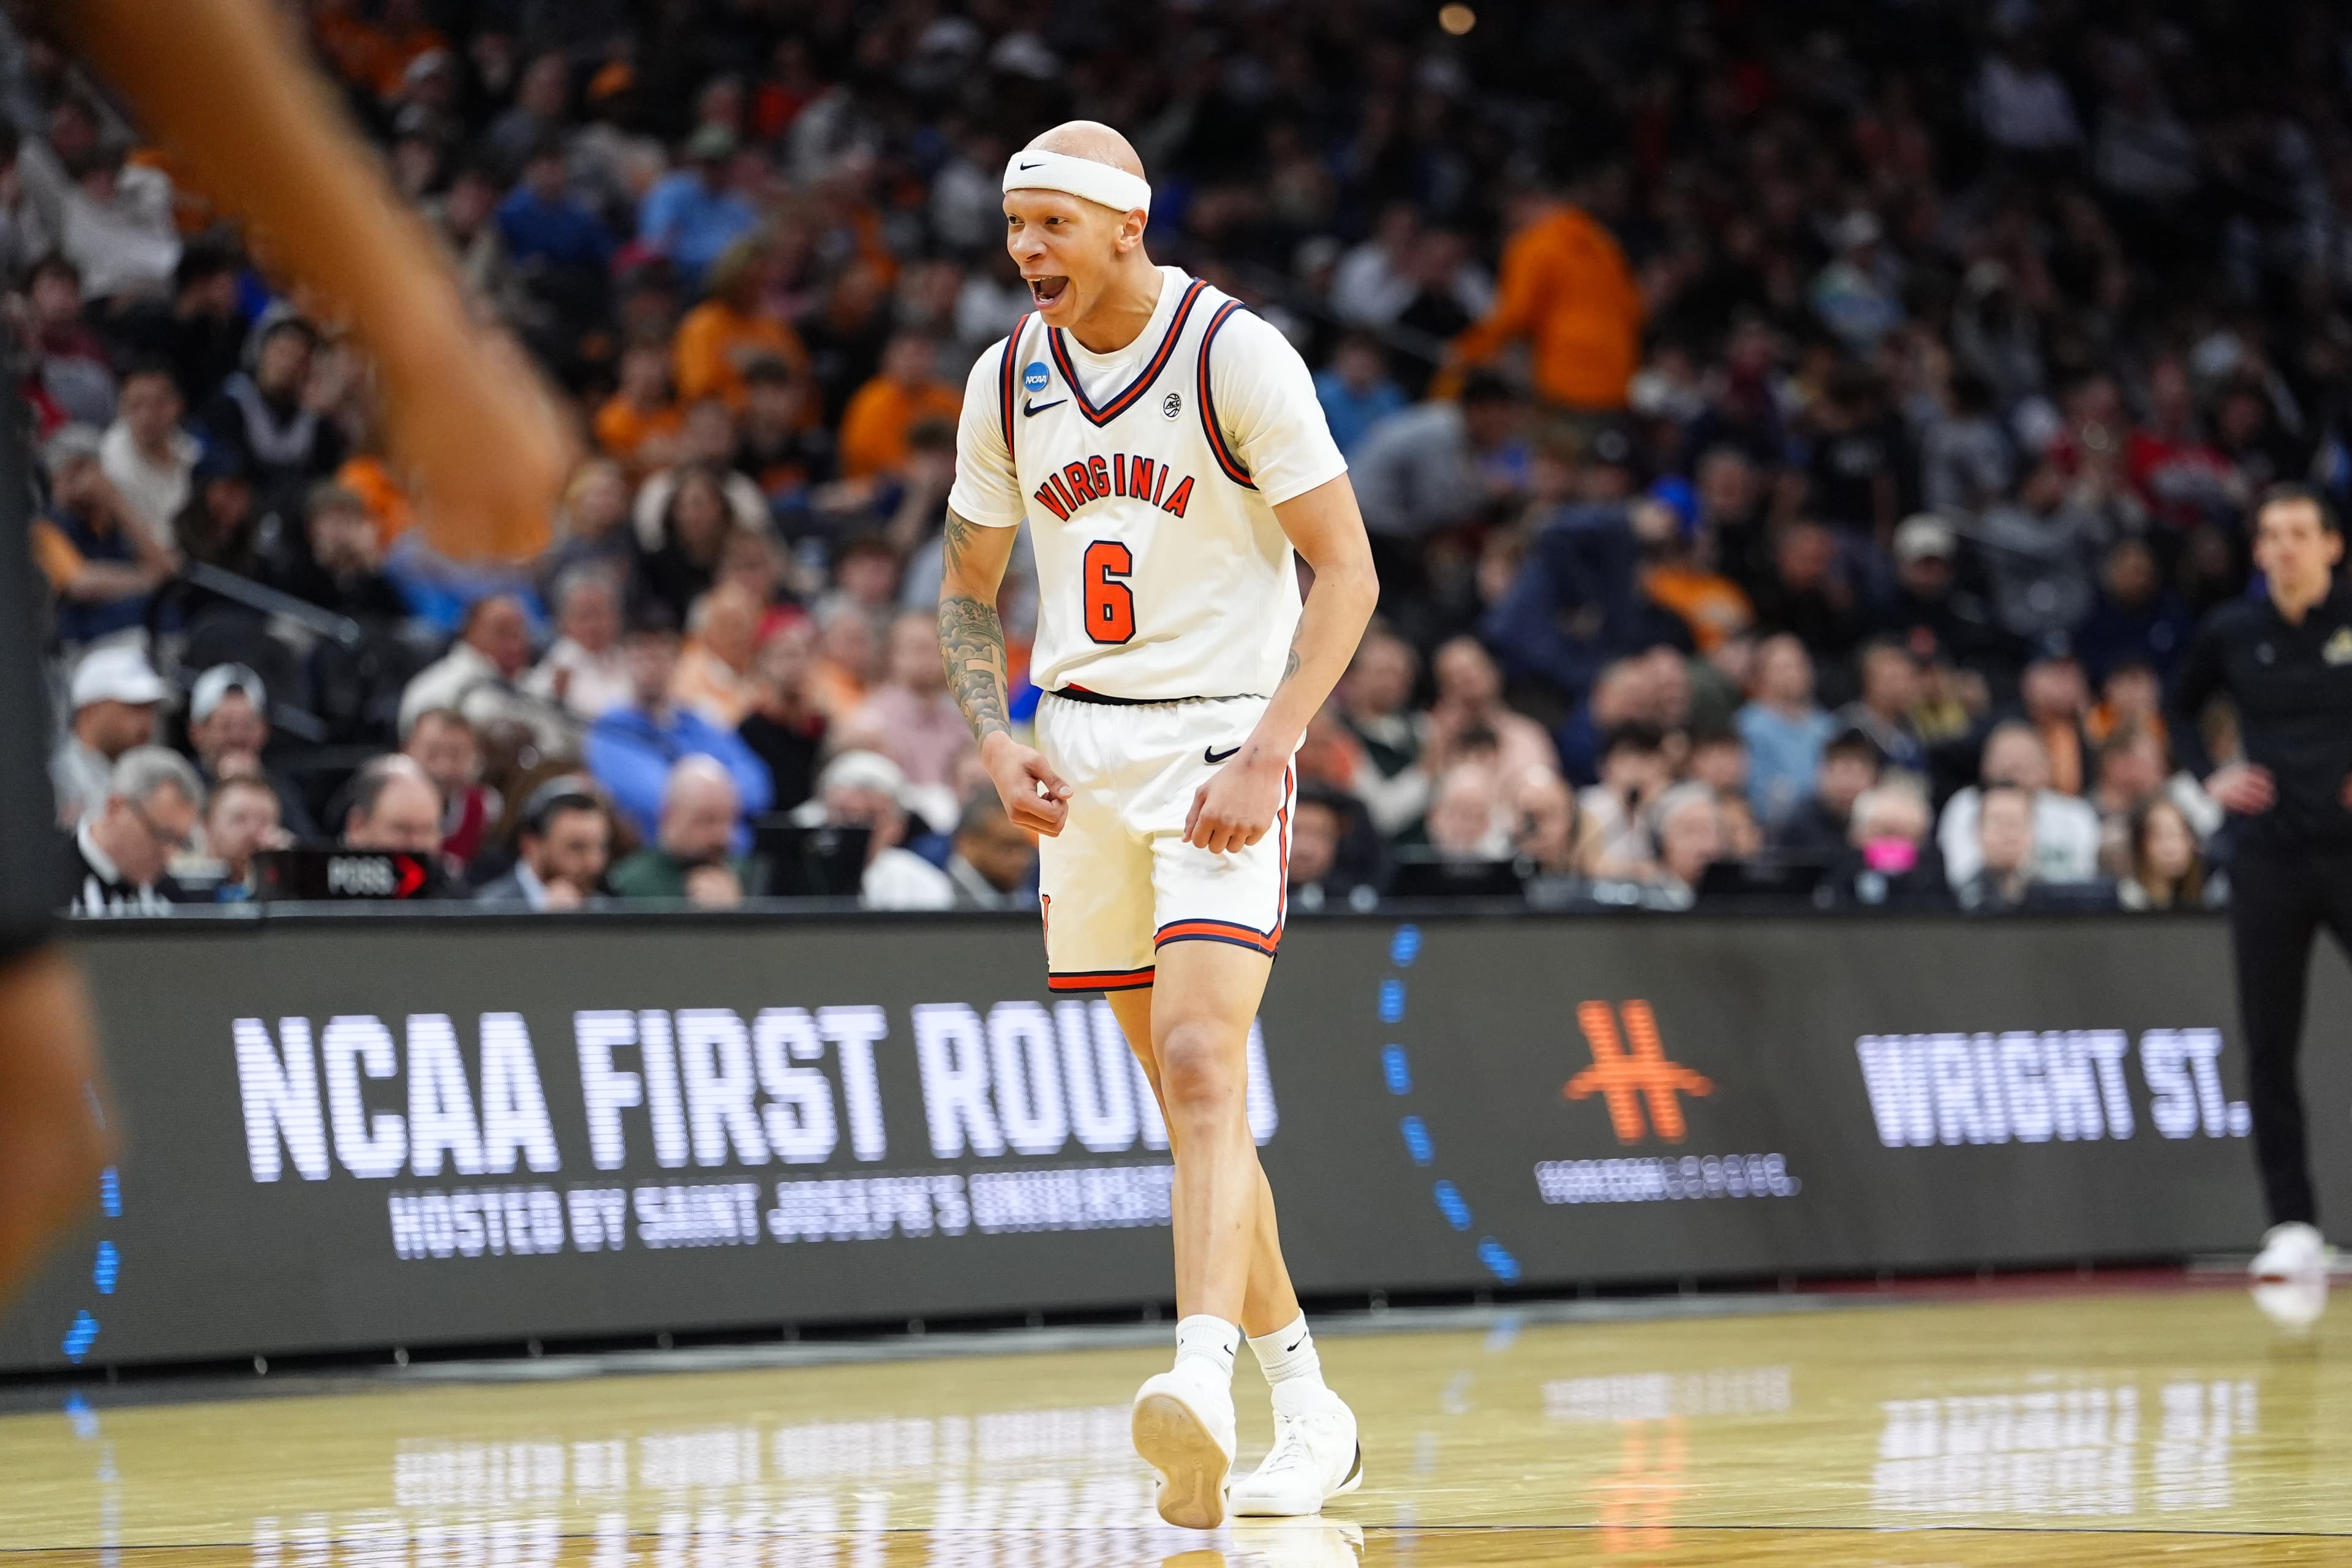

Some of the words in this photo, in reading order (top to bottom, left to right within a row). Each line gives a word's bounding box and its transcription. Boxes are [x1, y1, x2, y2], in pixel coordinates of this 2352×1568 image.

[1025, 375, 1047, 385] NCAA
[1165, 399, 1180, 409] ACC
[1035, 454, 1194, 521] VIRGINIA
[1084, 540, 1136, 644] 6
[232, 1012, 562, 1182] NCAA
[573, 1005, 889, 1170] FIRST
[1855, 1030, 2134, 1147] WRIGHT
[2138, 1027, 2252, 1139] ST.
[387, 1186, 565, 1260] HOSTED
[566, 1188, 627, 1252] BY
